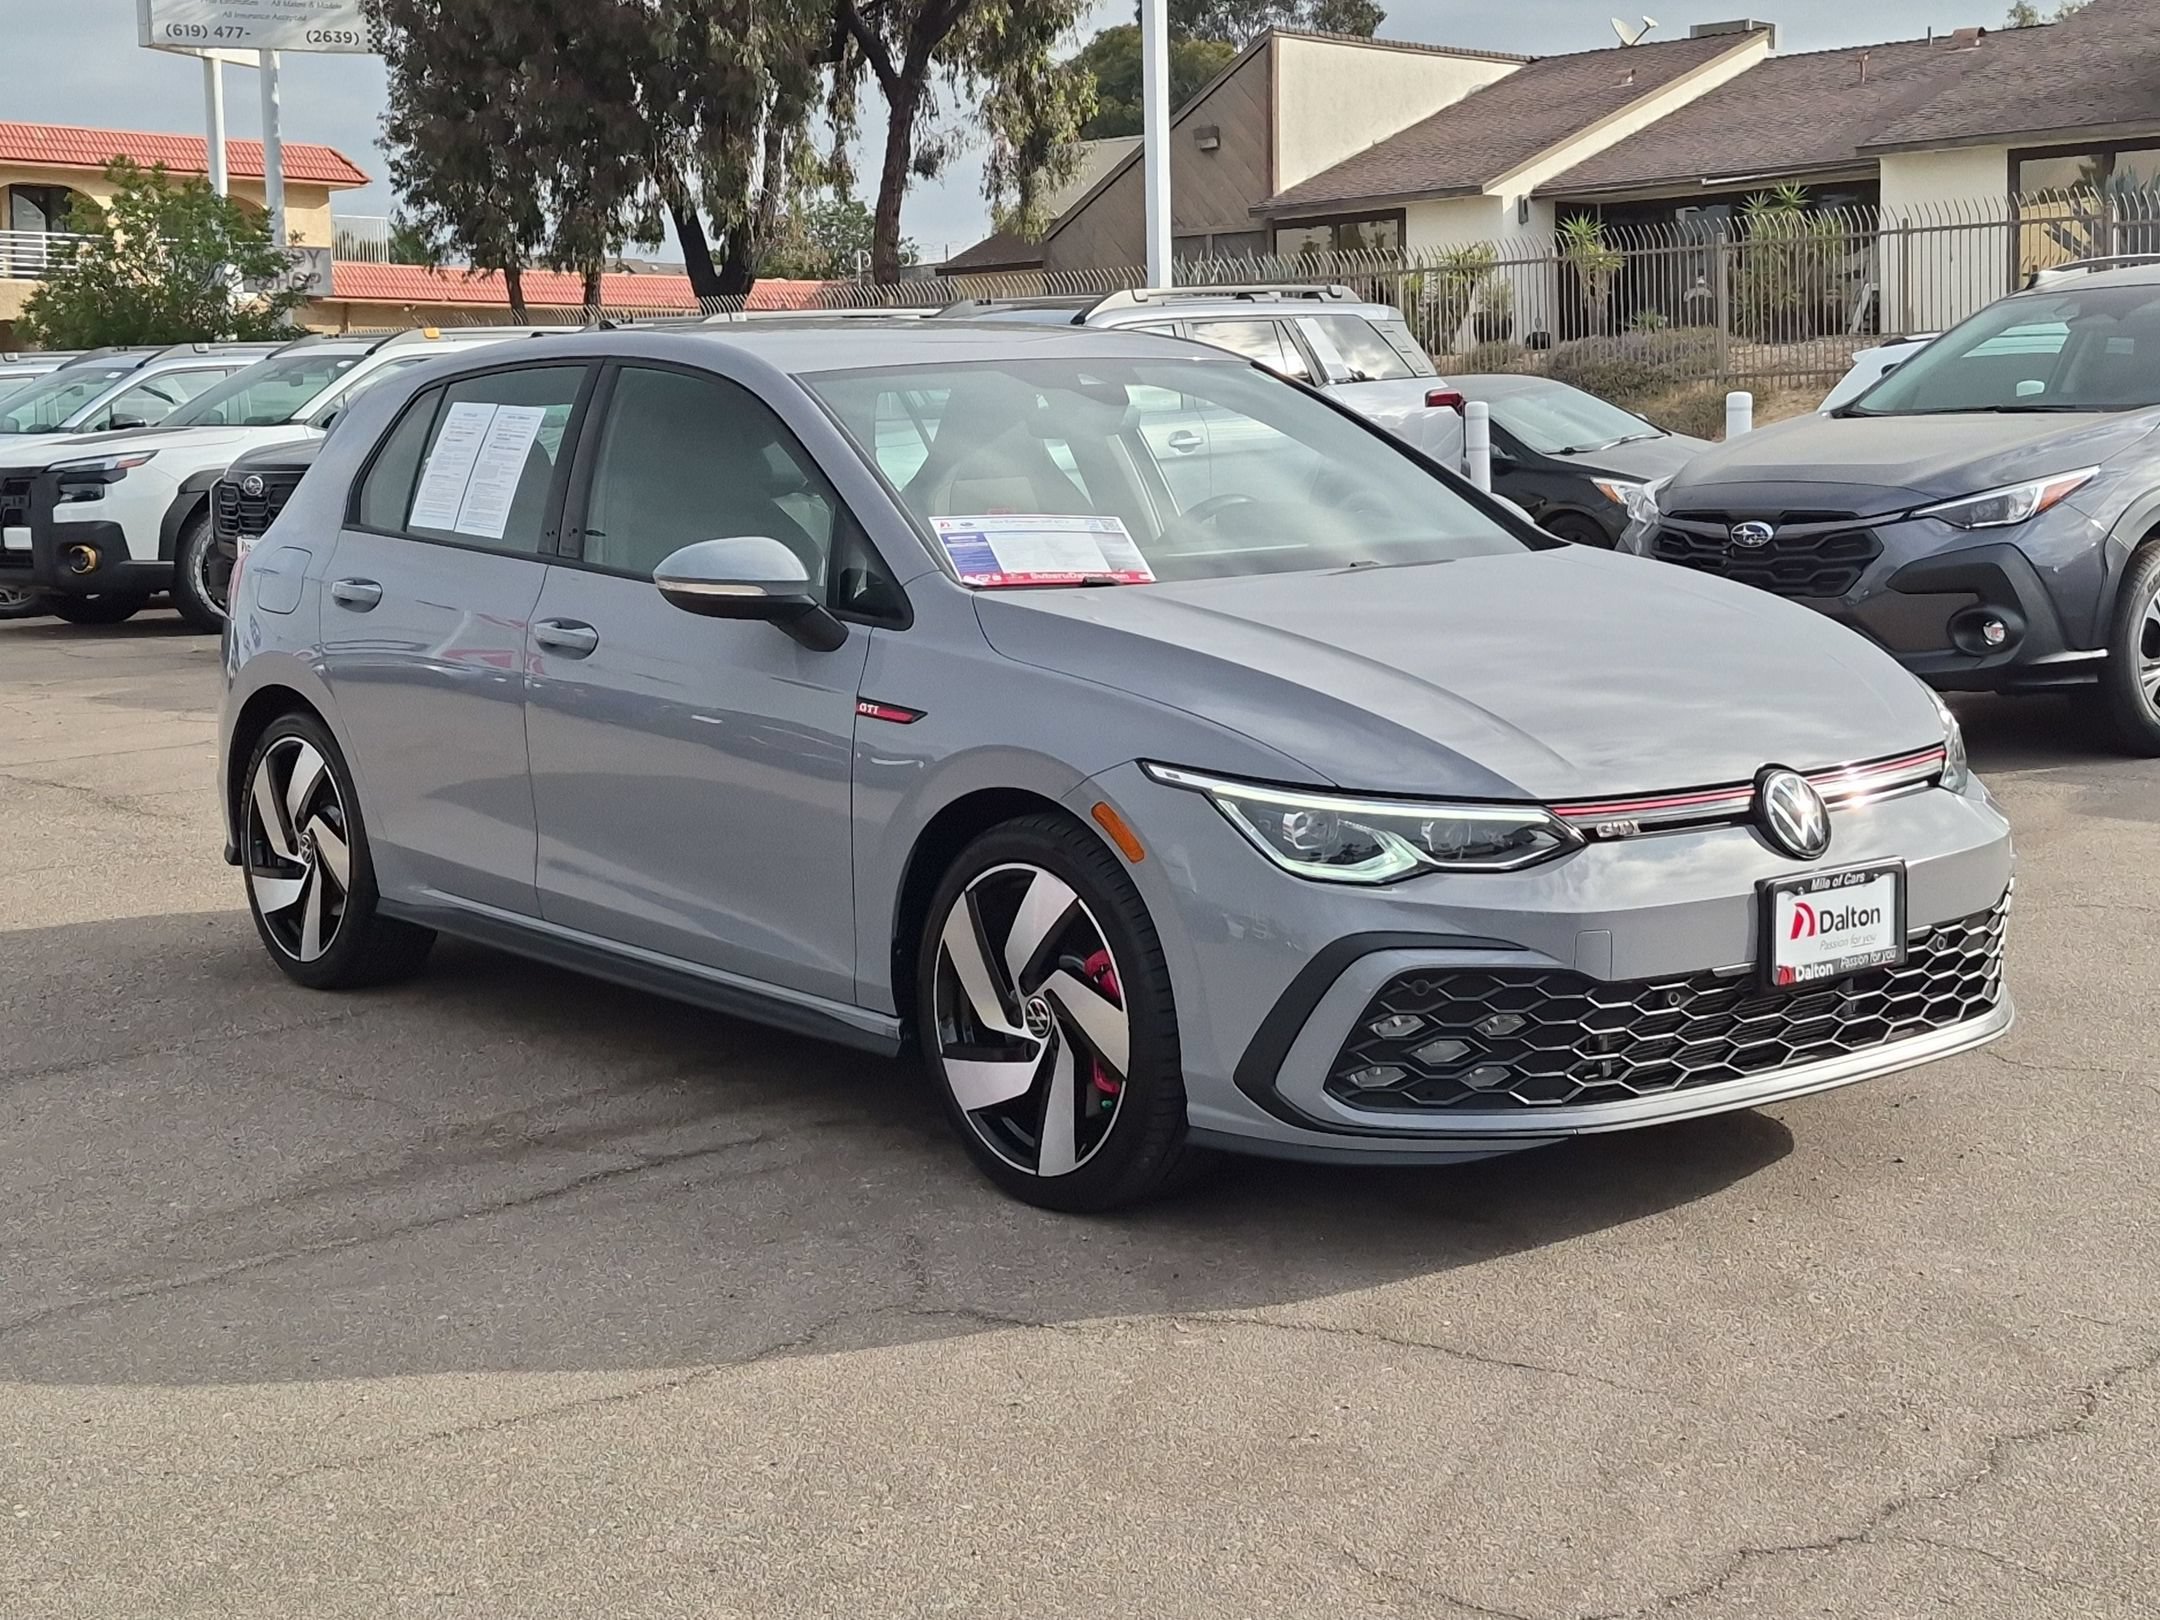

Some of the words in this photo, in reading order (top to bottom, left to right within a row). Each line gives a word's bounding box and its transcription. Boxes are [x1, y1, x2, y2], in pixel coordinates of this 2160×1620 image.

[165, 23, 208, 39] (619)
[213, 25, 251, 39] 477-
[306, 30, 360, 46] (2639)
[859, 702, 880, 715] GTI
[1811, 878, 1831, 891] Mile
[1832, 875, 1843, 887] of
[1843, 873, 1865, 886] Cars
[1819, 905, 1881, 934] Dalton
[1819, 937, 1849, 951] Passion
[1850, 935, 1862, 945] for
[1862, 933, 1877, 944] you
[1795, 963, 1834, 983] Dalton
[1839, 954, 1869, 969] Passion
[1870, 951, 1881, 963] for
[1881, 949, 1897, 963] you
